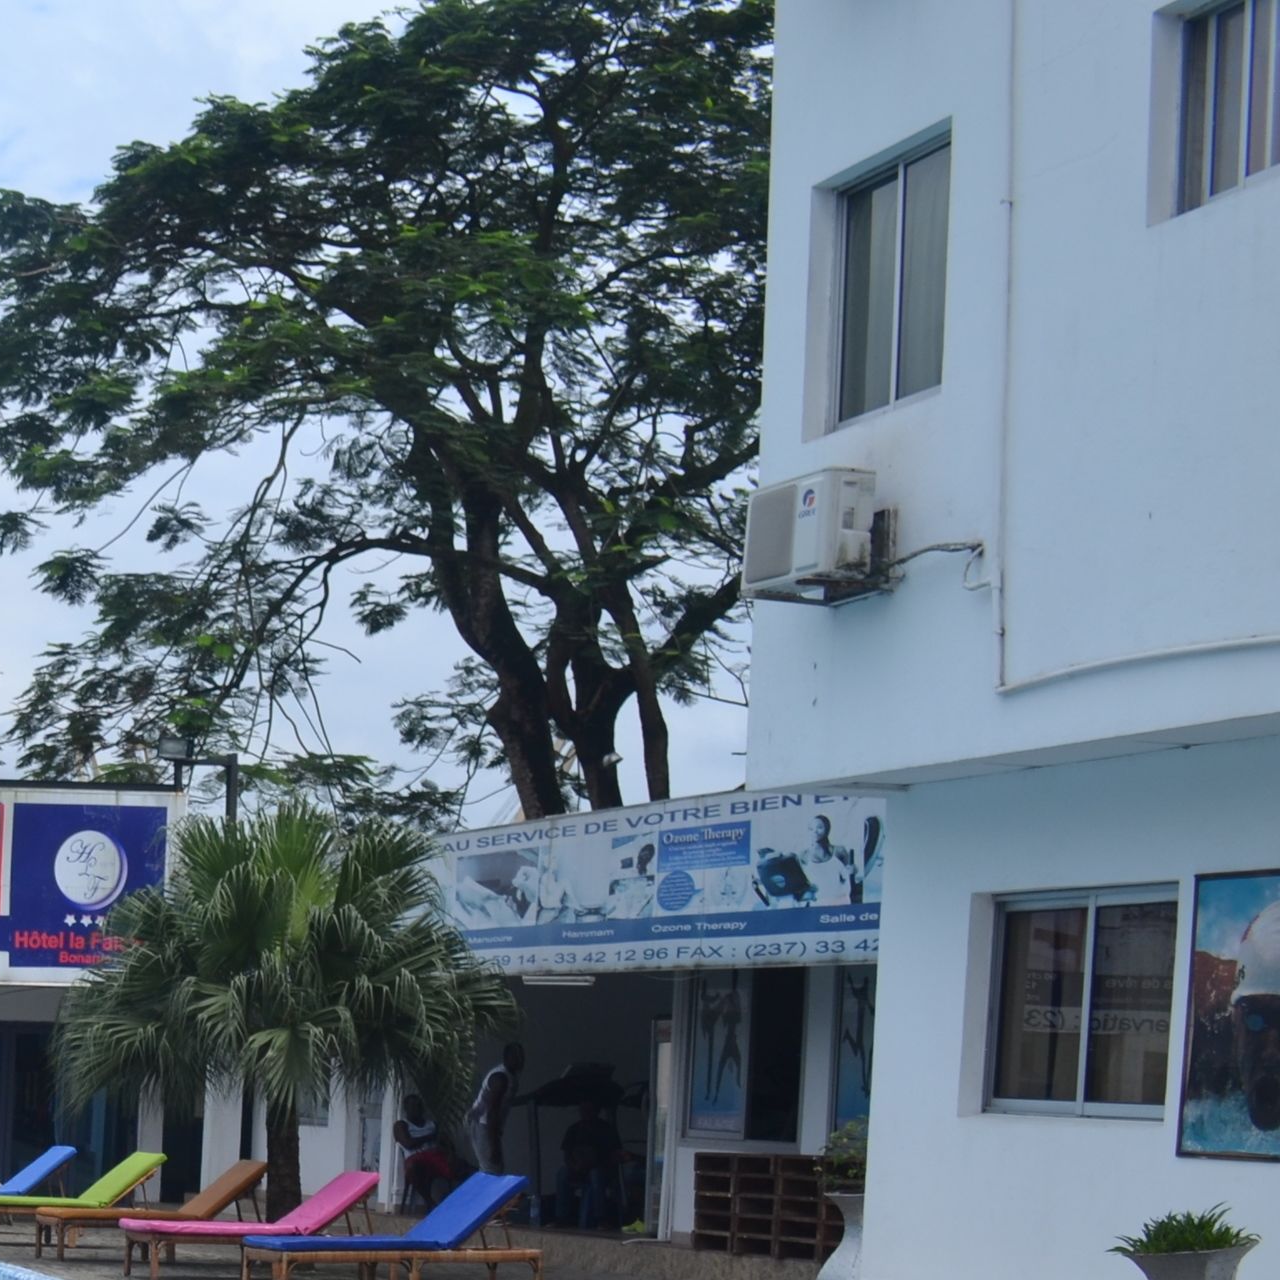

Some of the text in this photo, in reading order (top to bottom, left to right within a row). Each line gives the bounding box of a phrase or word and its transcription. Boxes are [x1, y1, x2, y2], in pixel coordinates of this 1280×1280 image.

[441, 839, 470, 853] AU
[476, 825, 576, 849] SERVICE
[584, 819, 618, 835] DE
[626, 804, 721, 828] VOTRE
[730, 794, 802, 816] BIEN
[663, 827, 745, 844] Ozone Therapy
[562, 927, 615, 938] Hammam
[651, 922, 691, 933] Ozone
[695, 920, 747, 933] Therapy
[819, 912, 855, 924] Salle
[859, 911, 879, 921] de
[14, 930, 64, 949] Hôtel
[69, 931, 85, 949] la
[518, 953, 536, 965] 14
[554, 953, 577, 964] 33
[583, 951, 606, 963] 42
[615, 950, 636, 962] 12
[643, 948, 669, 961] 96
[676, 945, 724, 959] FAX
[745, 941, 807, 960] (237)
[815, 940, 845, 954] 33
